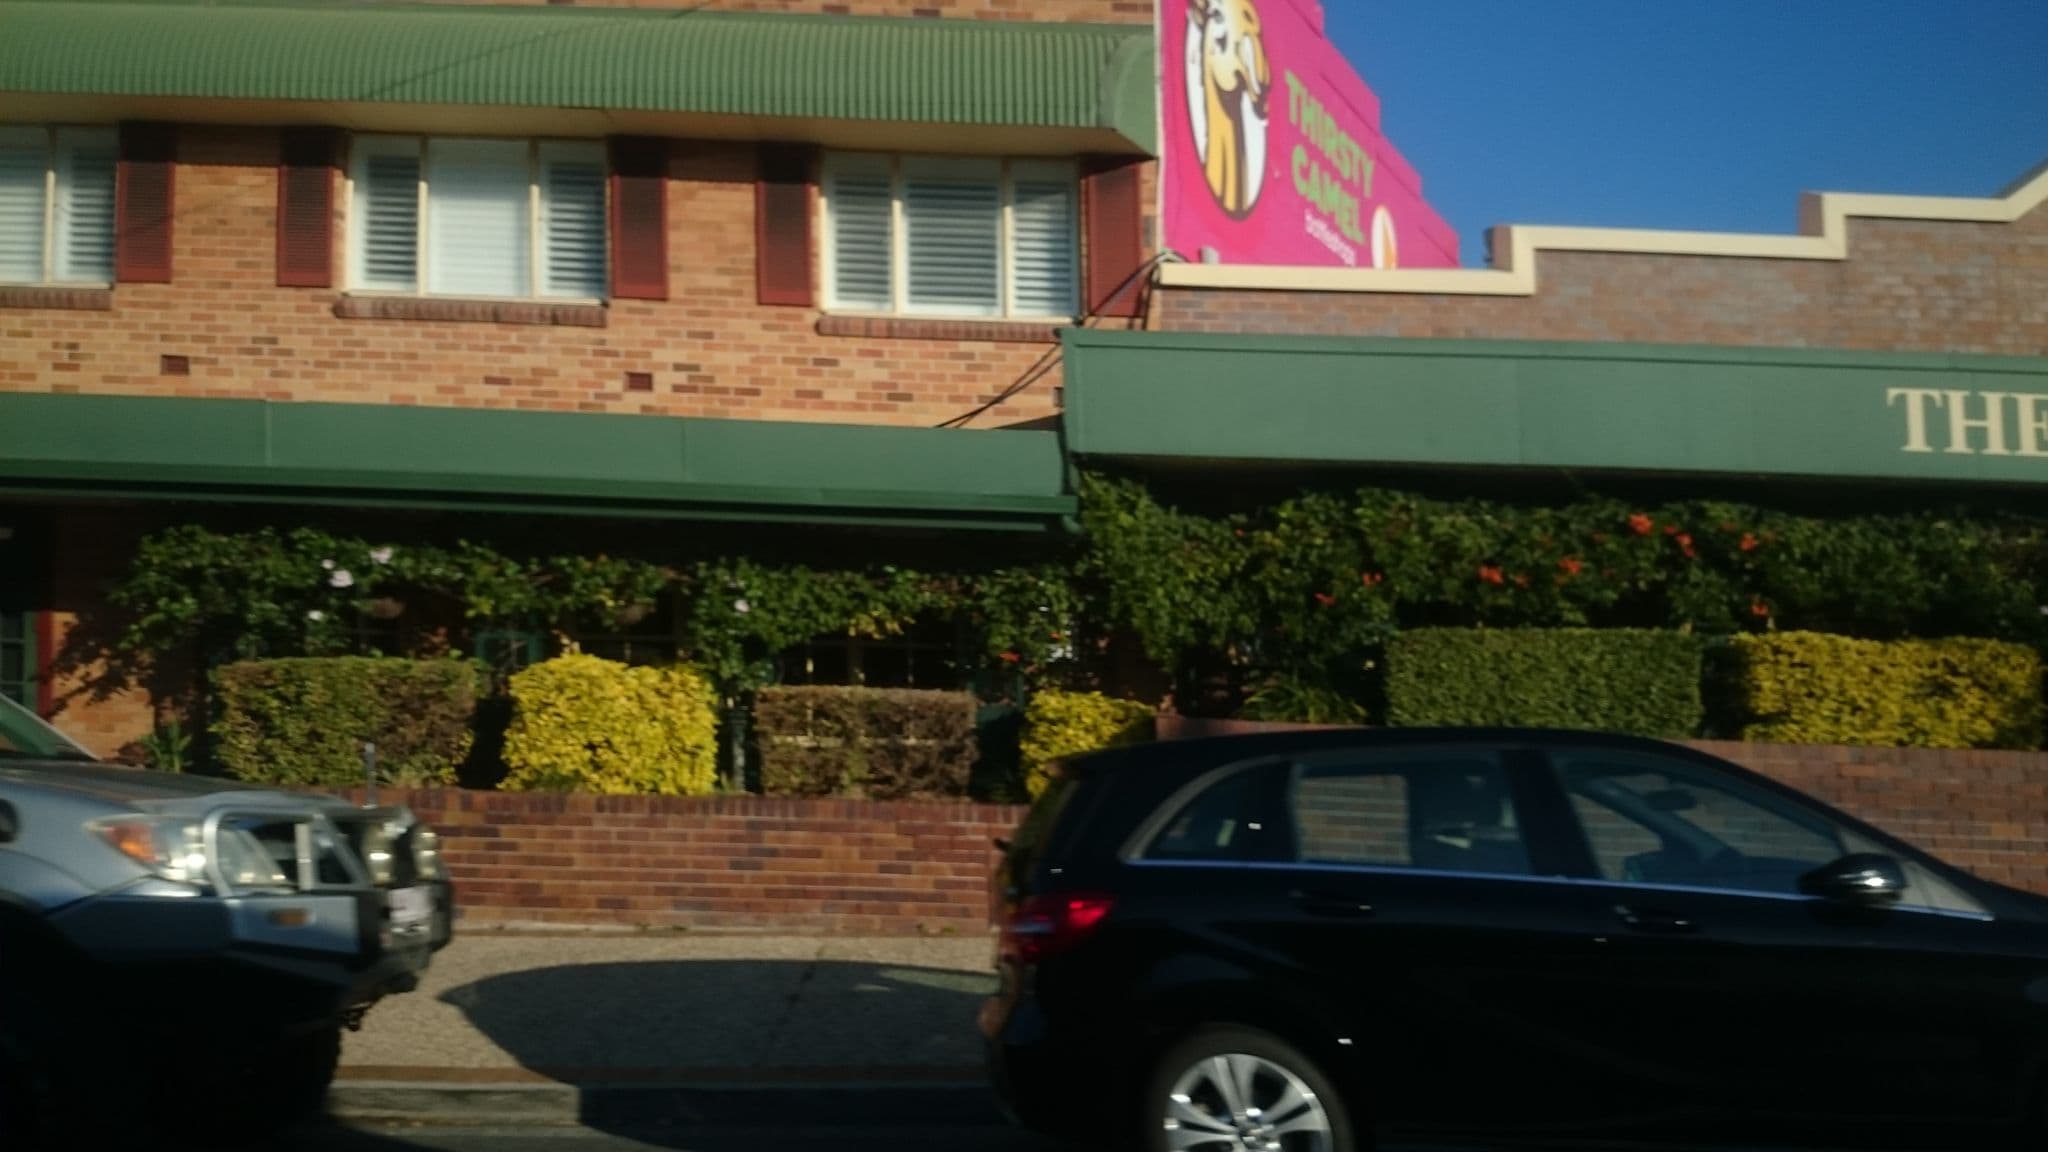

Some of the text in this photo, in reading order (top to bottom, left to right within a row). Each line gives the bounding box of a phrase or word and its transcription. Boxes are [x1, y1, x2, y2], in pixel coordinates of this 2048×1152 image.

[1285, 69, 1374, 199] THIRSTY
[1291, 144, 1365, 244] CAMEL
[1886, 387, 2048, 457] THE
